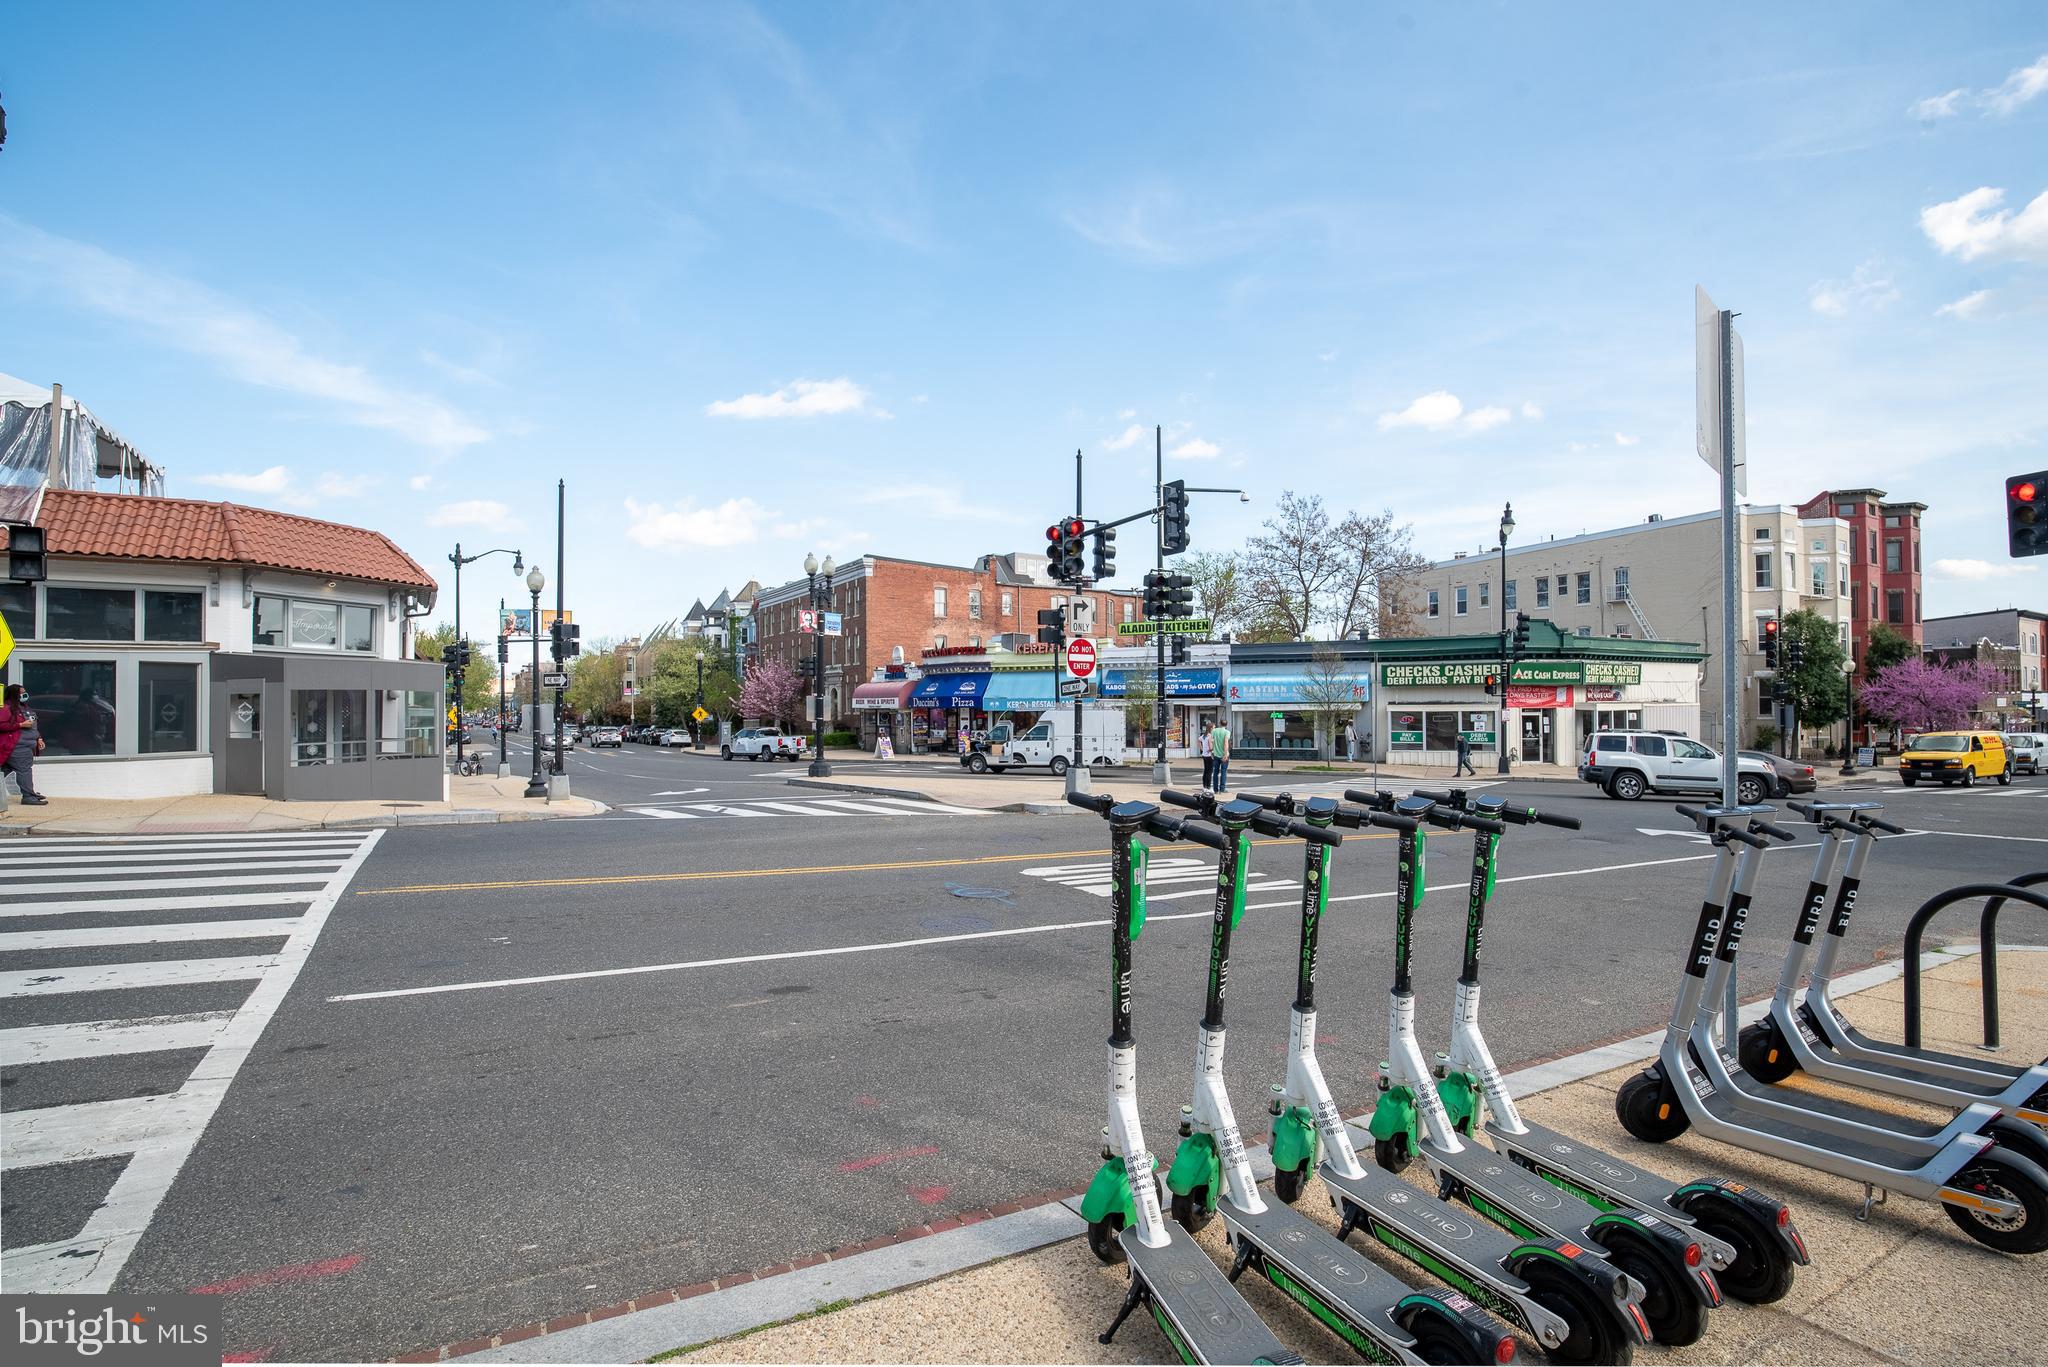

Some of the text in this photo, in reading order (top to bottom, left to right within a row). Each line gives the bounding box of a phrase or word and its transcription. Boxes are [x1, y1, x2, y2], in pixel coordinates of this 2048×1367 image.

[1073, 622, 1090, 632] ONLY
[1120, 620, 1209, 634] ALADDI KITCHEN
[1071, 645, 1079, 653] DO
[1387, 664, 1500, 677] CHECKS CASHED
[1513, 667, 1580, 680] ACE CASH EXPRESS
[1585, 664, 1639, 677] CHECKS CASHED
[1197, 682, 1216, 690] GYRO
[1387, 675, 1501, 685] DEBIT CARDS PAY BIS
[1586, 675, 1639, 684] DEBIT CARDS PAY BILLS
[1229, 686, 1241, 699] 東
[912, 697, 940, 707] Duccini's
[951, 696, 975, 707] Pizza
[1215, 895, 1227, 922] Lime
[1306, 890, 1318, 915] Lime
[1838, 890, 1857, 927] BIRD
[1803, 895, 1825, 934] BIRD
[1726, 907, 1749, 951] BIRD
[1697, 918, 1721, 965] BIRD
[1120, 969, 1132, 1015] Lime
[1412, 1205, 1457, 1233] Lime
[1484, 1203, 1512, 1229] Lime
[1391, 1235, 1421, 1262] Lime
[1283, 1275, 1311, 1307] Lime
